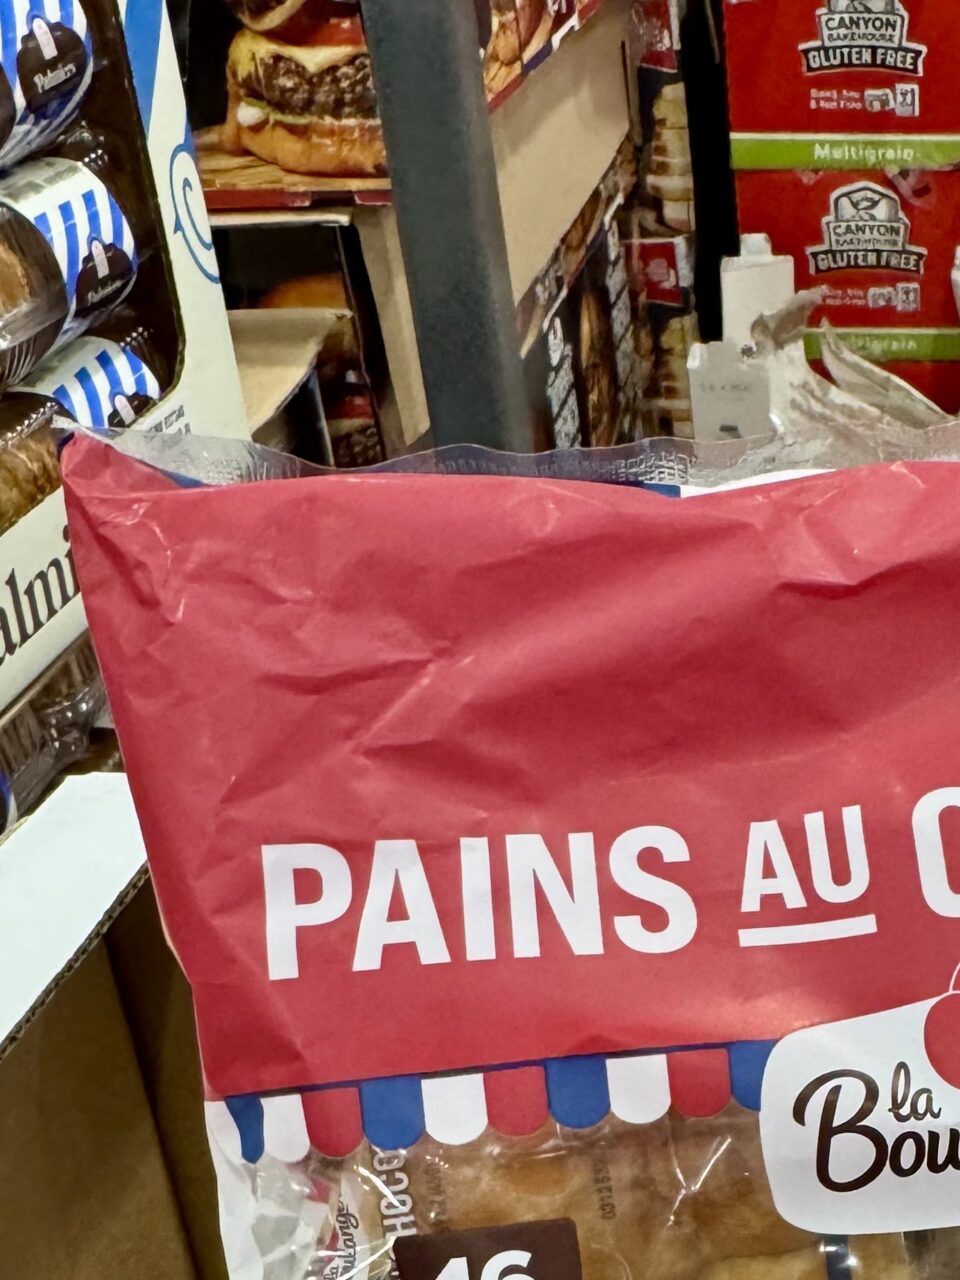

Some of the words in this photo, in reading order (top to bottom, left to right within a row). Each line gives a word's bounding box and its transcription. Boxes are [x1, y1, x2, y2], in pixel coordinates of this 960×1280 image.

[825, 16, 898, 33] CANYON
[807, 47, 872, 69] GLUTEN
[876, 48, 917, 69] FREE
[813, 143, 914, 163] Multigrain
[832, 223, 900, 238] CANYON
[816, 251, 878, 271] GLUTEN
[261, 825, 698, 981] PAINS
[738, 804, 870, 913] AU
[888, 1061, 941, 1123] la
